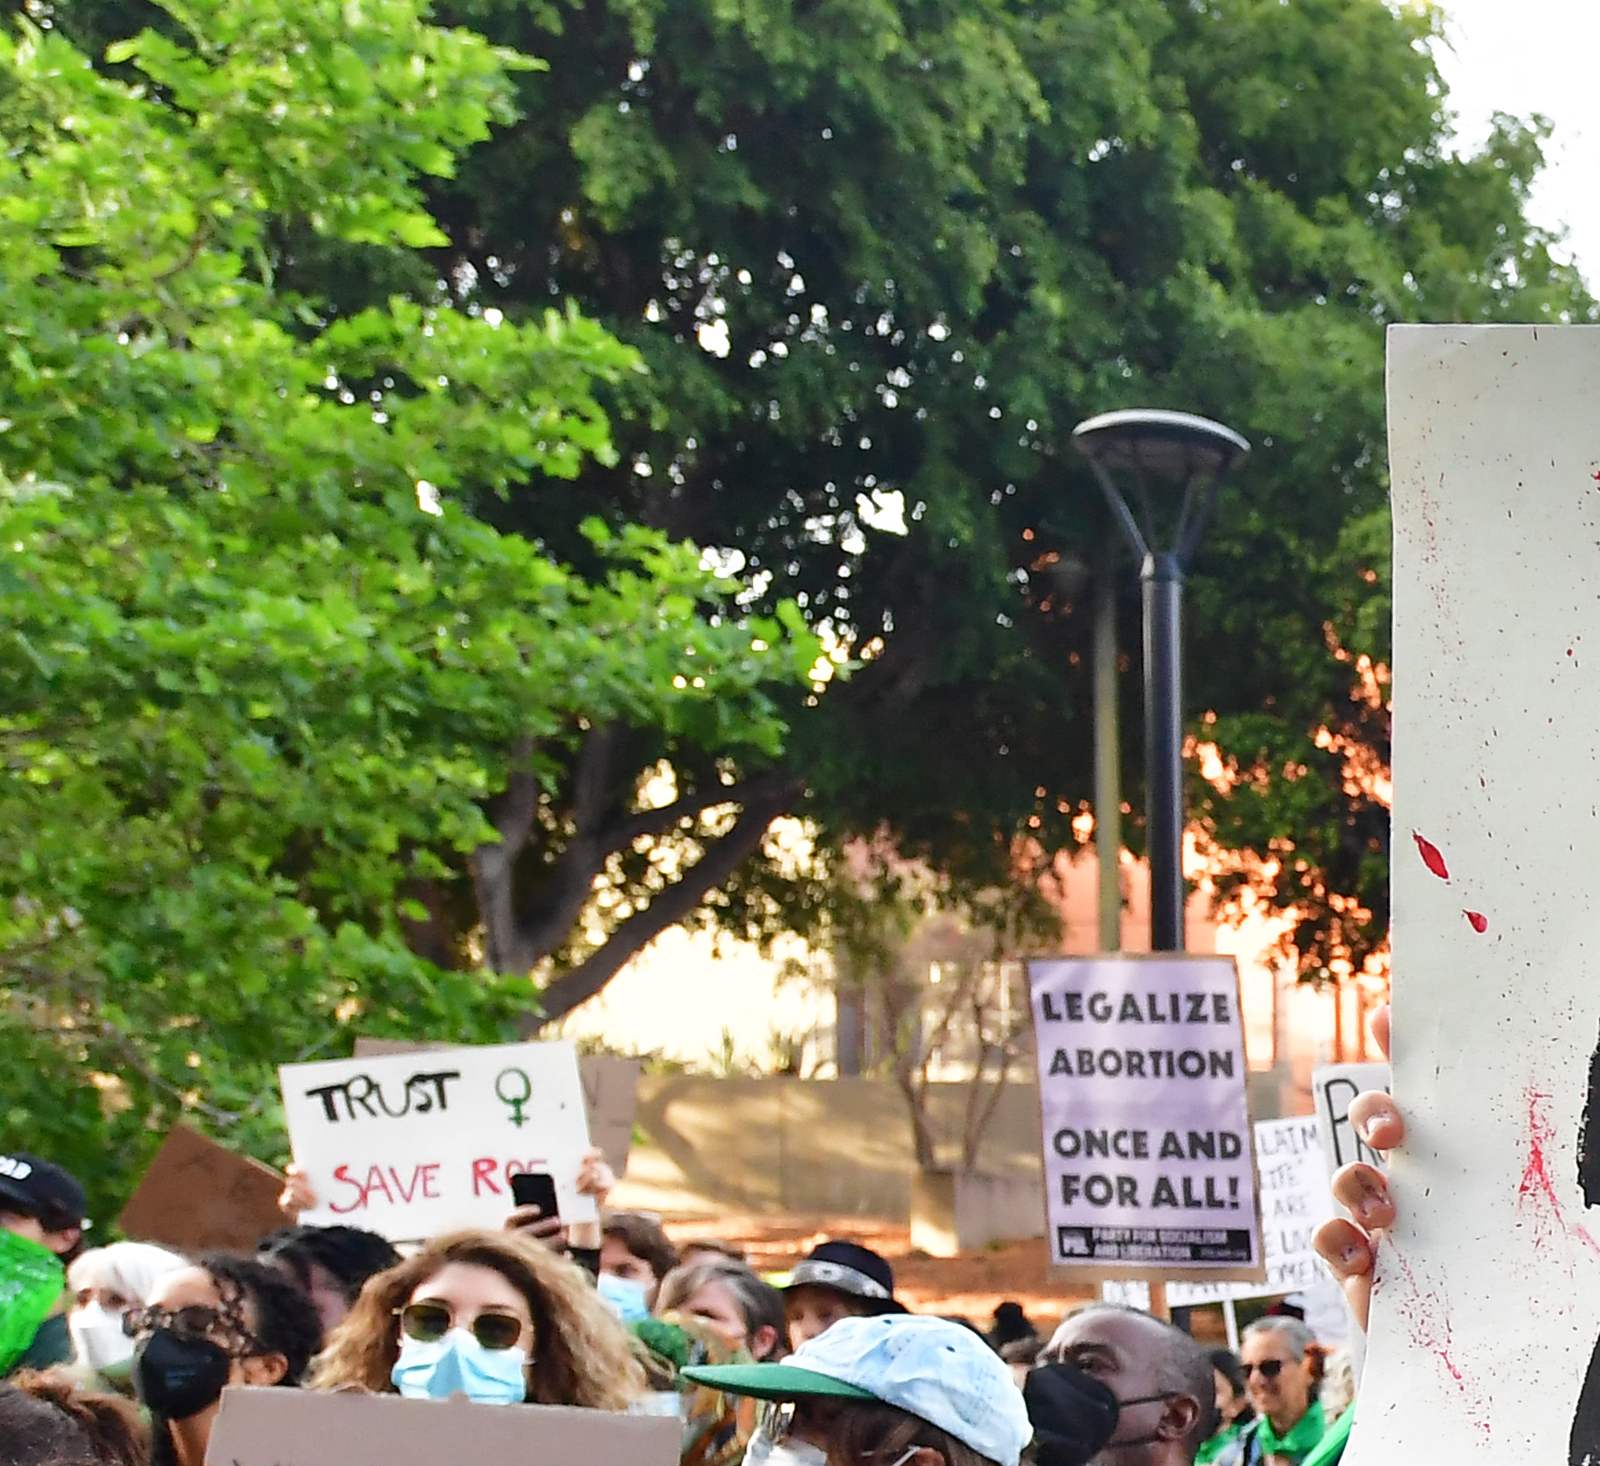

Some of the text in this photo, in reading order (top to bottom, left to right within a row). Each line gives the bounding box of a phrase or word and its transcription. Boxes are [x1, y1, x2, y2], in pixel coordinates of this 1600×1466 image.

[1042, 992, 1231, 1025] LEGALIZE
[1049, 1049, 1234, 1079] ABORTION
[306, 1070, 460, 1122] TRUST
[1053, 1129, 1242, 1161] ONCE AND
[329, 1163, 440, 1213] SAVE
[1060, 1175, 1240, 1211] FOR ALL!
